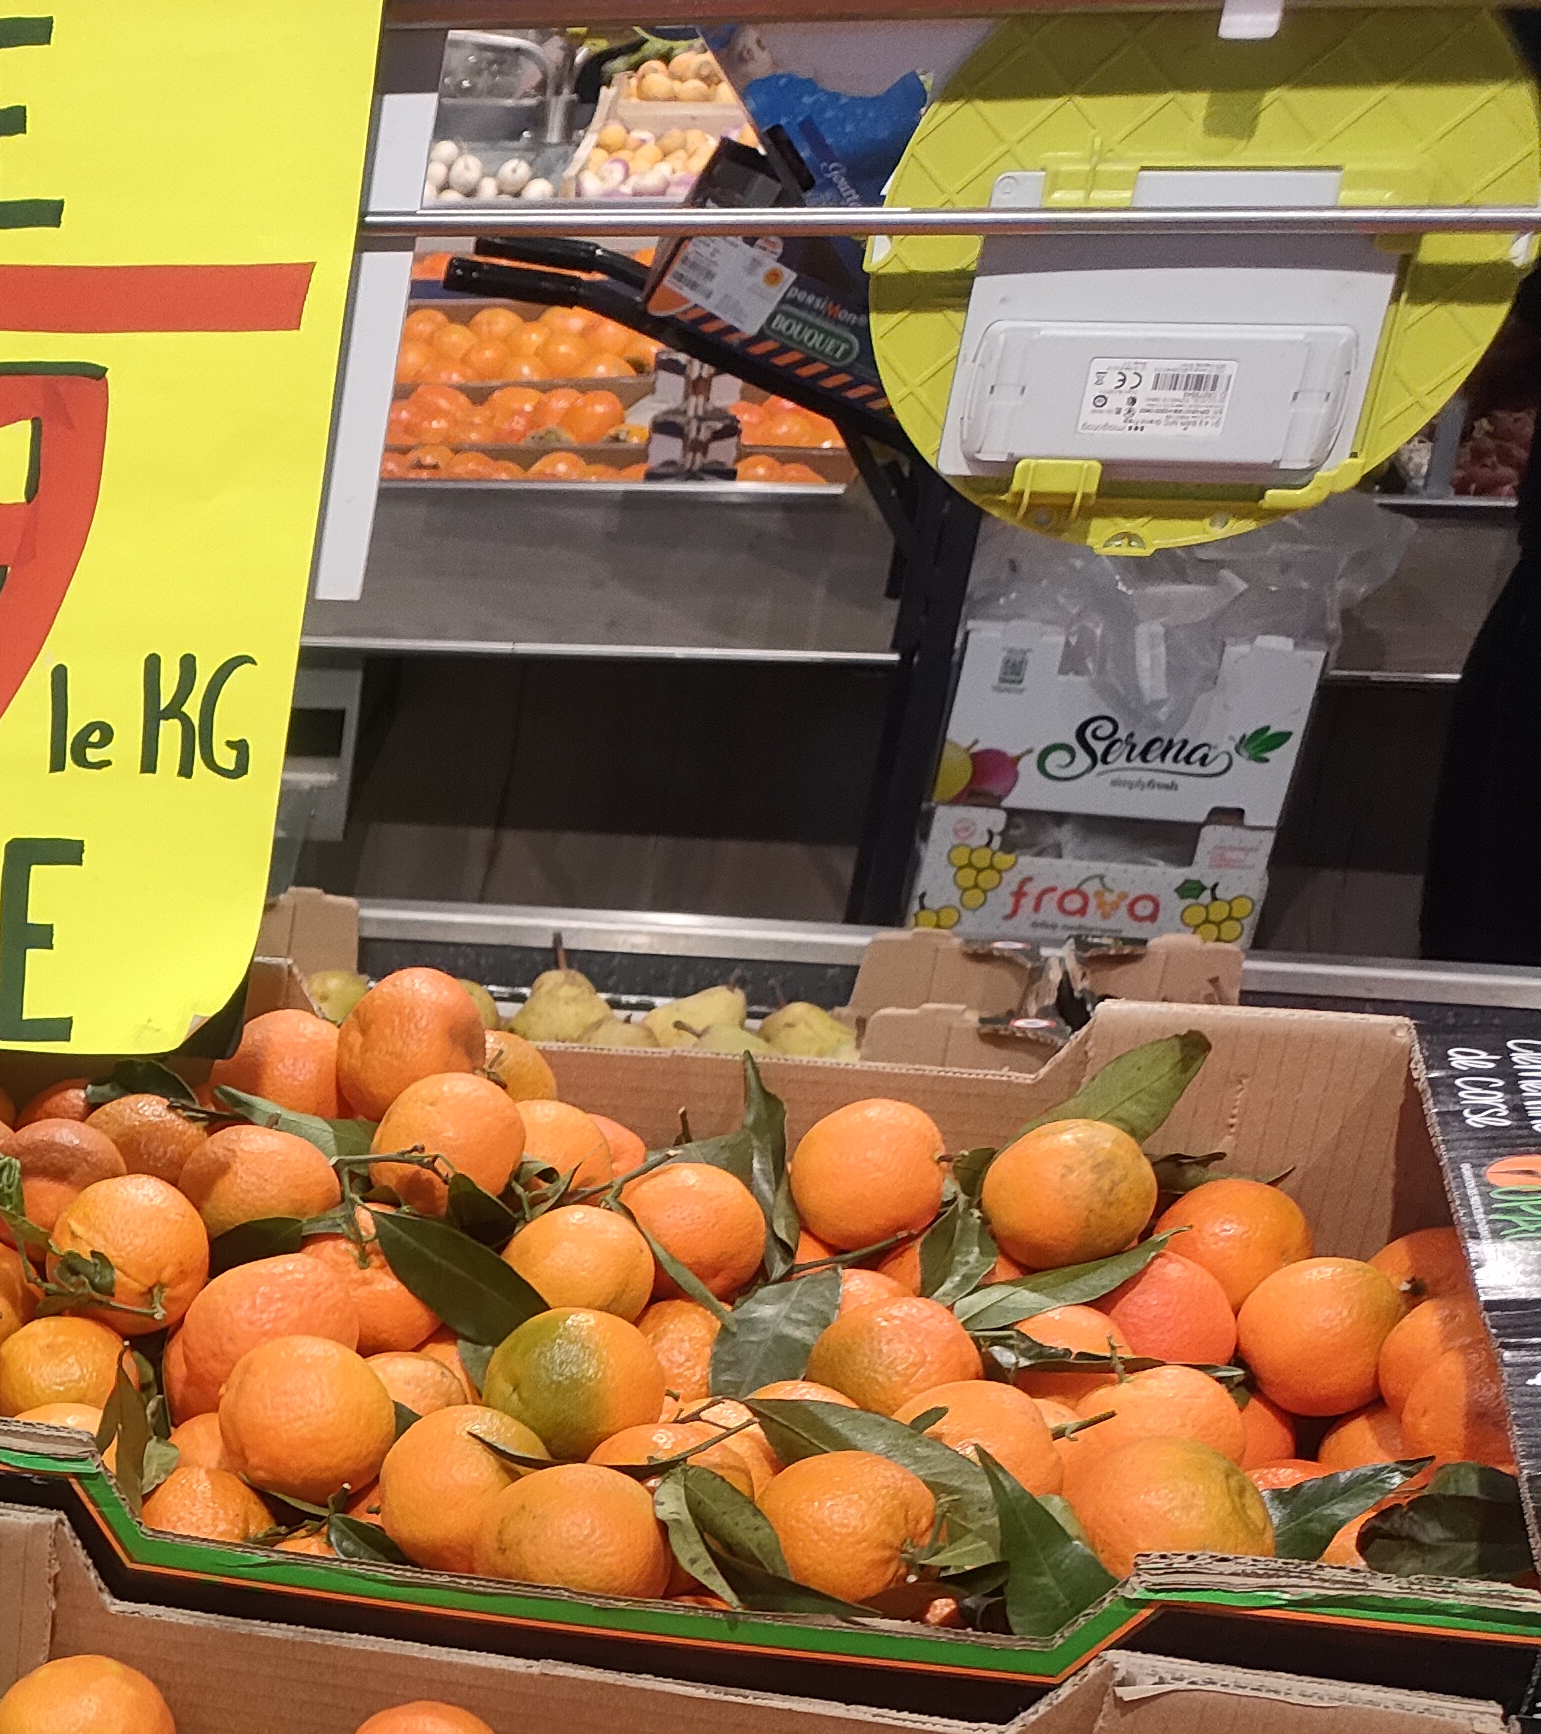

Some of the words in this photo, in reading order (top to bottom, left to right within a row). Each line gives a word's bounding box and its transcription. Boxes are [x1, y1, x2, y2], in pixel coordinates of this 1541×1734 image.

[771, 312, 851, 360] BOUQUET
[47, 665, 116, 777] le
[139, 653, 259, 781] KG
[1037, 715, 1233, 782] Serena
[1002, 875, 1160, 923] frava
[1447, 1047, 1503, 1071] de
